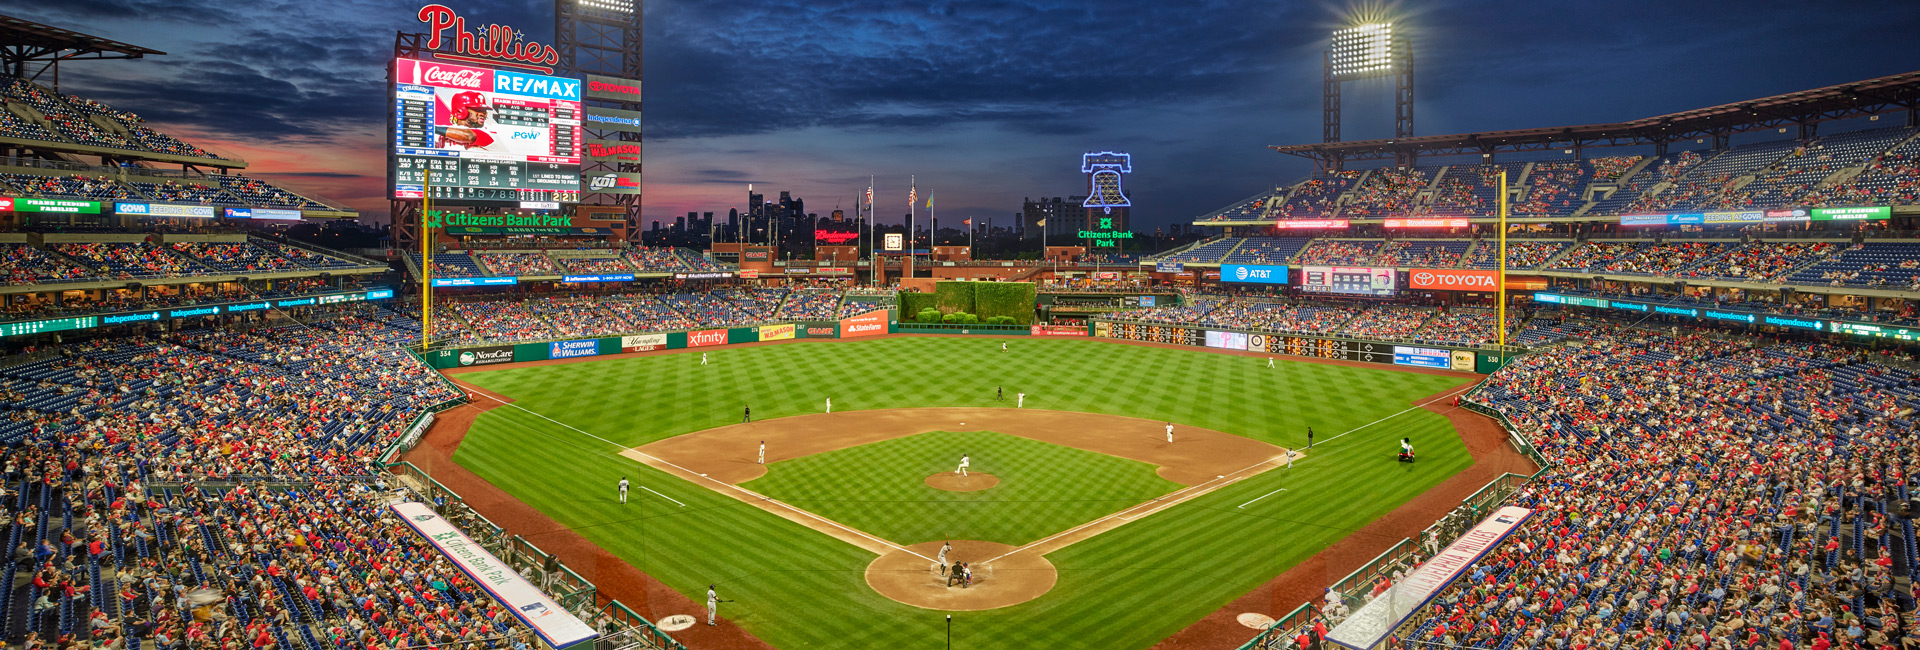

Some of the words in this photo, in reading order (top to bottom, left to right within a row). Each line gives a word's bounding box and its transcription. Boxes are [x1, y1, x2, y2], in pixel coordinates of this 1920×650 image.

[418, 4, 559, 66] Phillies
[424, 66, 485, 88] Coca-Cola
[498, 75, 576, 98] RE/MAX
[601, 83, 640, 95] TOYOTA
[588, 114, 632, 125] Independence
[500, 190, 506, 199] 8
[509, 191, 515, 199] 9
[553, 193, 560, 201] 2
[562, 193, 569, 201] 2
[572, 194, 578, 202] 1
[120, 204, 146, 213] GOYA
[150, 206, 182, 214] FEEDING
[445, 214, 504, 226] Citizens
[507, 214, 541, 226] Bank
[543, 214, 572, 226] Park
[814, 230, 858, 240] Budweiser
[1112, 230, 1134, 239] Bank
[1096, 239, 1114, 247] Park
[1250, 269, 1272, 278] AT&T
[1436, 275, 1495, 286] TOYOTA
[228, 303, 264, 312] Independence
[279, 299, 310, 307] Independence
[1612, 302, 1642, 310] Independence
[171, 308, 212, 317] Independence
[1656, 306, 1690, 315] Independence
[1706, 310, 1746, 321] Independence
[104, 314, 151, 324] Independence
[1766, 316, 1813, 328] Independence
[690, 331, 726, 346] xfinity
[562, 341, 595, 350] SHERWIN
[475, 350, 513, 360] NovaCare
[1453, 530, 1498, 554] PHILLIES
[446, 539, 476, 559] Citizens
[468, 557, 496, 572] Bank
[485, 570, 512, 586] Park
